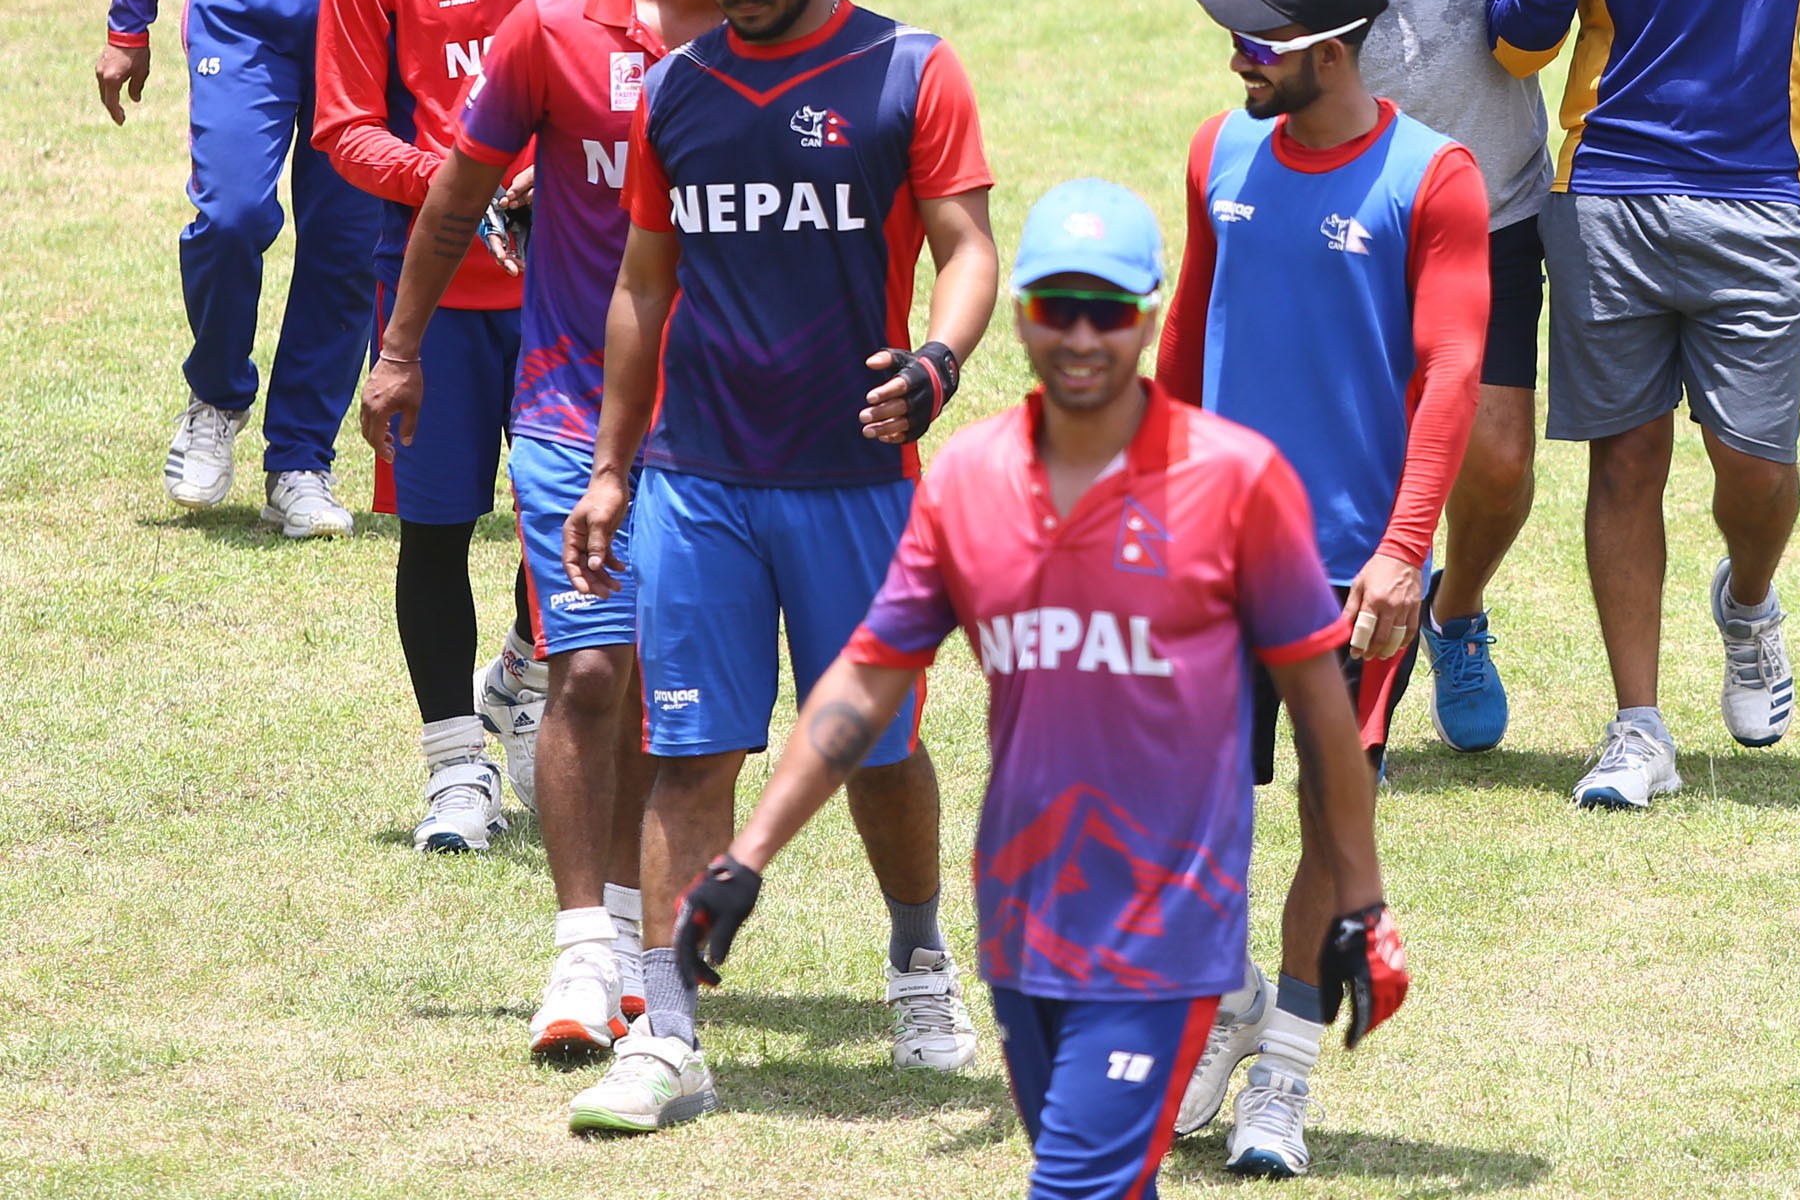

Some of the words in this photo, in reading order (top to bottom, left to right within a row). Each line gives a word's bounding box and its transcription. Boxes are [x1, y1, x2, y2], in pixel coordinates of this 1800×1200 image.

[197, 57, 220, 76] 45
[801, 138, 822, 148] CAN
[669, 182, 866, 234] NEPAL
[550, 590, 600, 609] praya
[976, 606, 1174, 677] NEPAL
